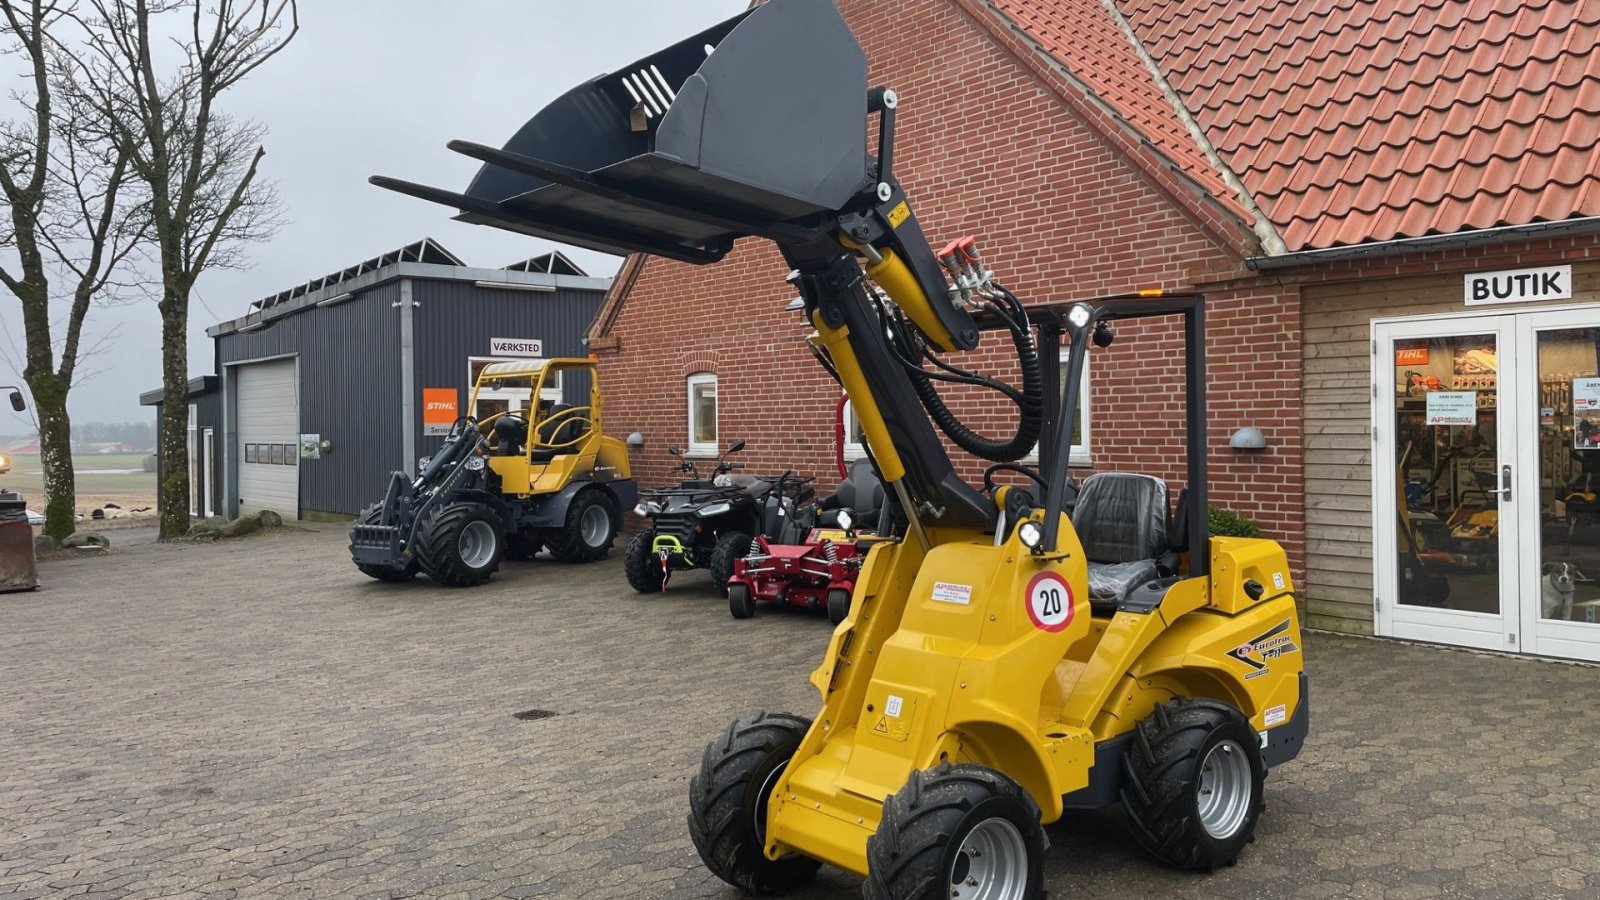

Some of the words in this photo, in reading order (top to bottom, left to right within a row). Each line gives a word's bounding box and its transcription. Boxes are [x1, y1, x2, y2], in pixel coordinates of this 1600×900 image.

[1472, 271, 1562, 300] BUTIK
[493, 342, 540, 352] VÆRKSTED
[1398, 350, 1424, 359] TIHL
[427, 402, 456, 410] STIHL
[1039, 588, 1062, 617] 20
